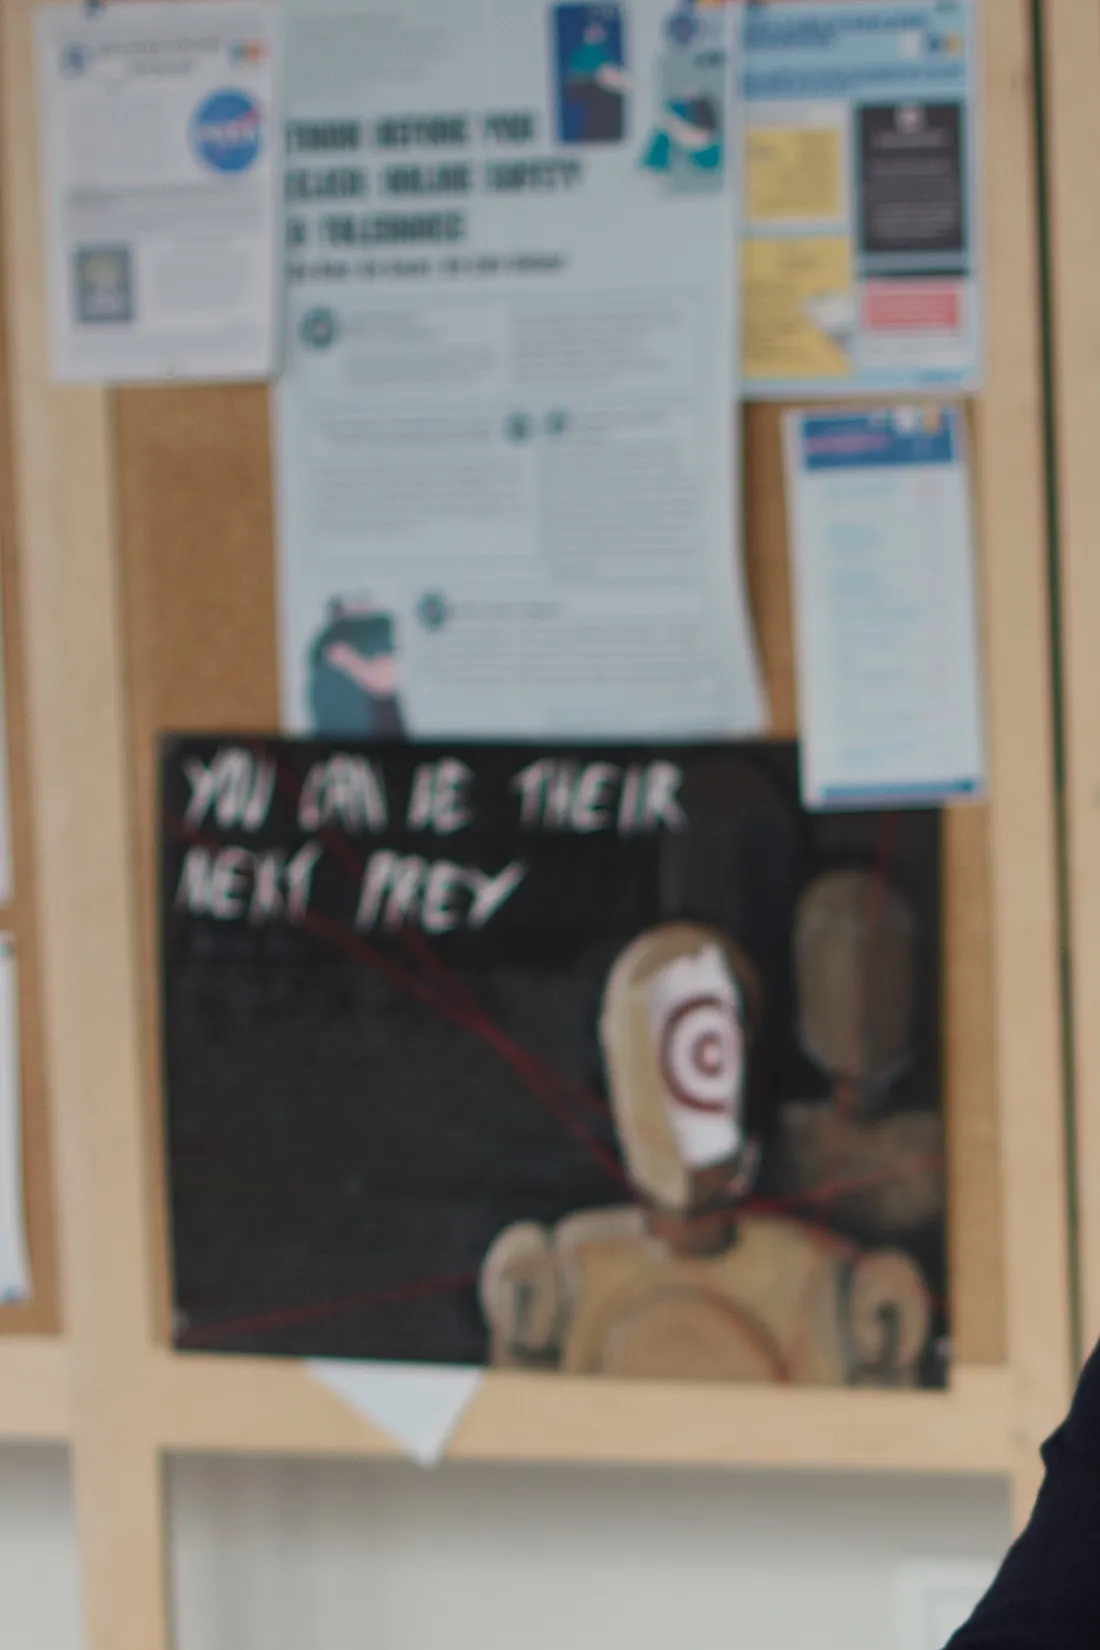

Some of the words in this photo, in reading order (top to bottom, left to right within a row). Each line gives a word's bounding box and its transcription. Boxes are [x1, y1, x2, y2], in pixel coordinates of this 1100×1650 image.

[184, 746, 277, 832] YOU
[299, 752, 388, 834] CAN
[407, 756, 474, 834] BE
[512, 757, 690, 834] THEIR
[177, 842, 322, 924] NEXT
[354, 846, 529, 934] PREY
